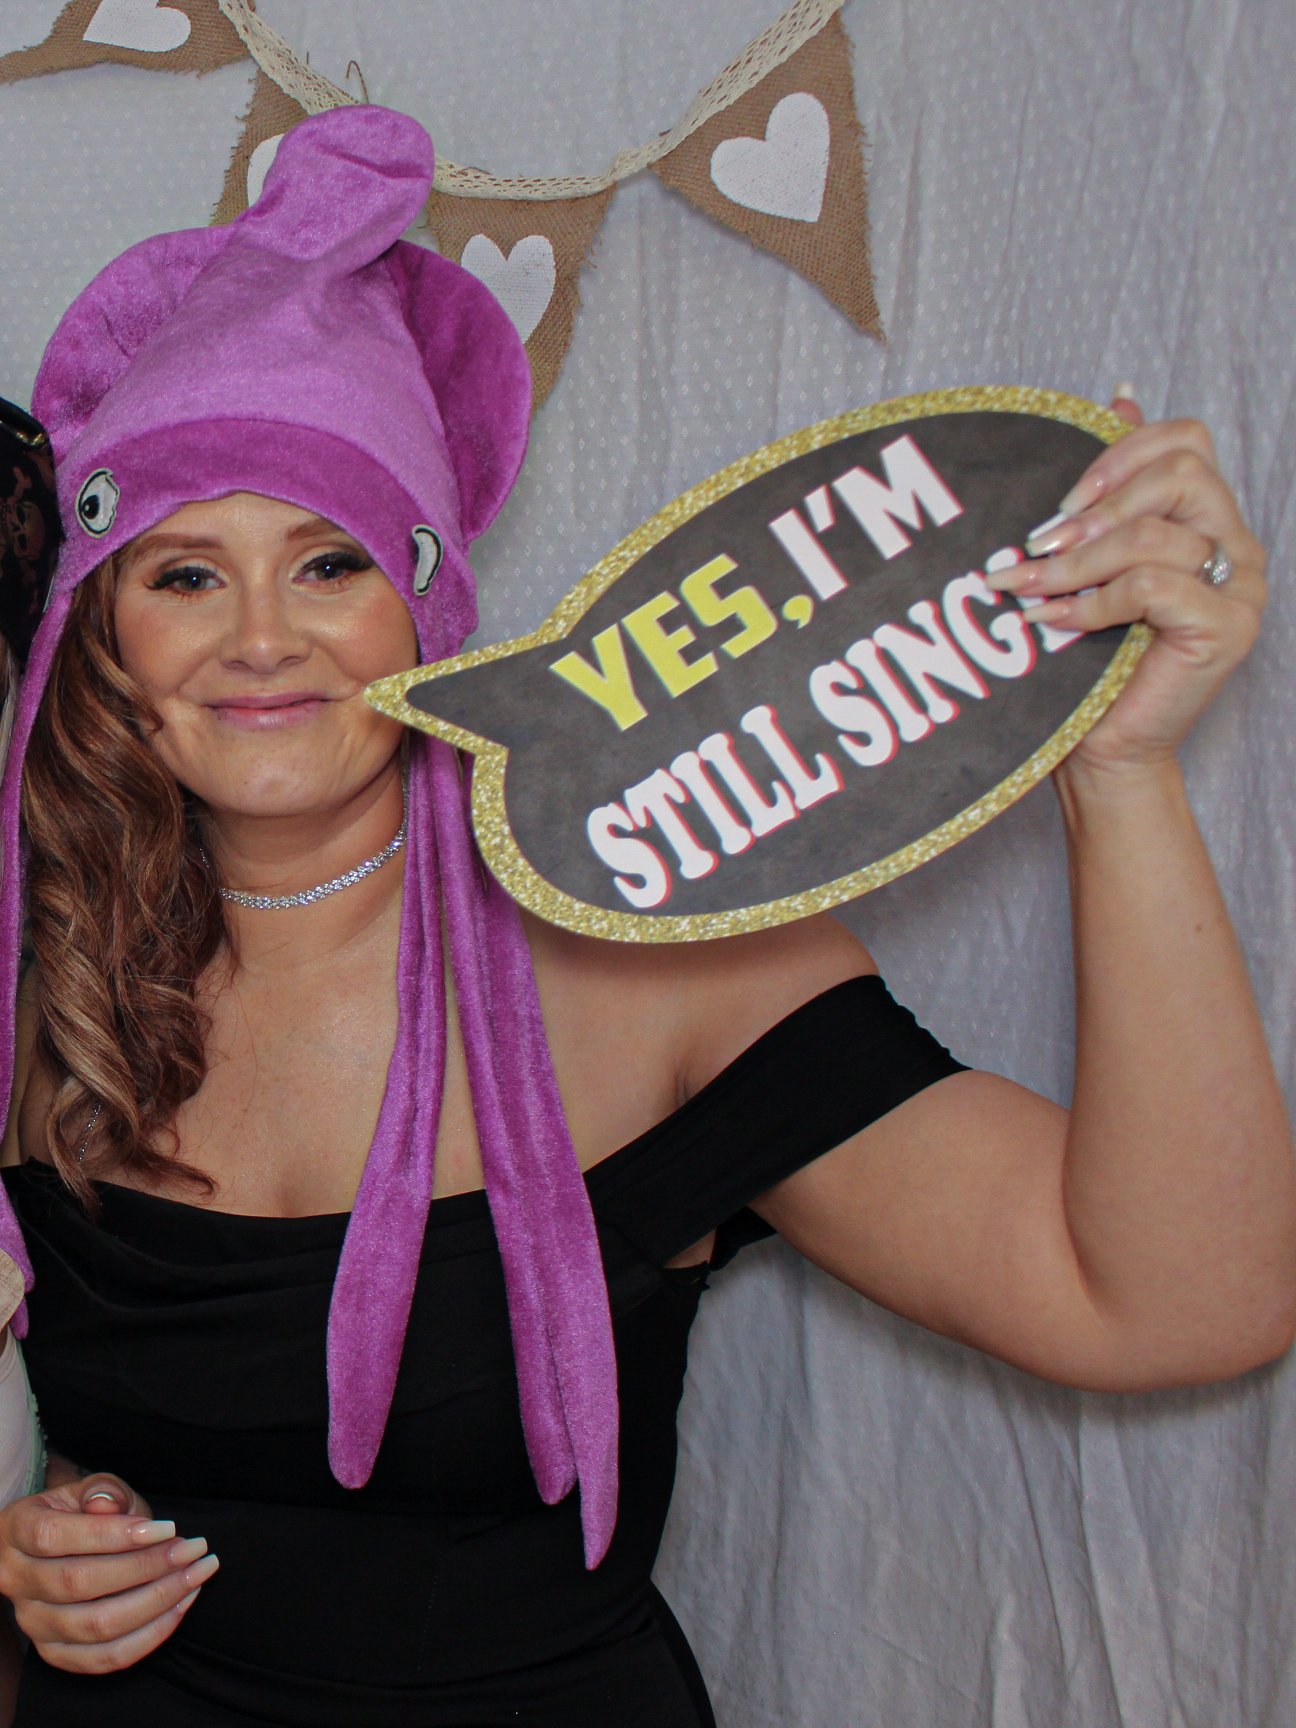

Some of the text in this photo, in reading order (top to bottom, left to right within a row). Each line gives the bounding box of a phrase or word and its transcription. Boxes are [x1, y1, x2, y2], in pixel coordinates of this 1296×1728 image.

[550, 434, 964, 732] YES, I'M
[586, 545, 1099, 910] STILL SING
